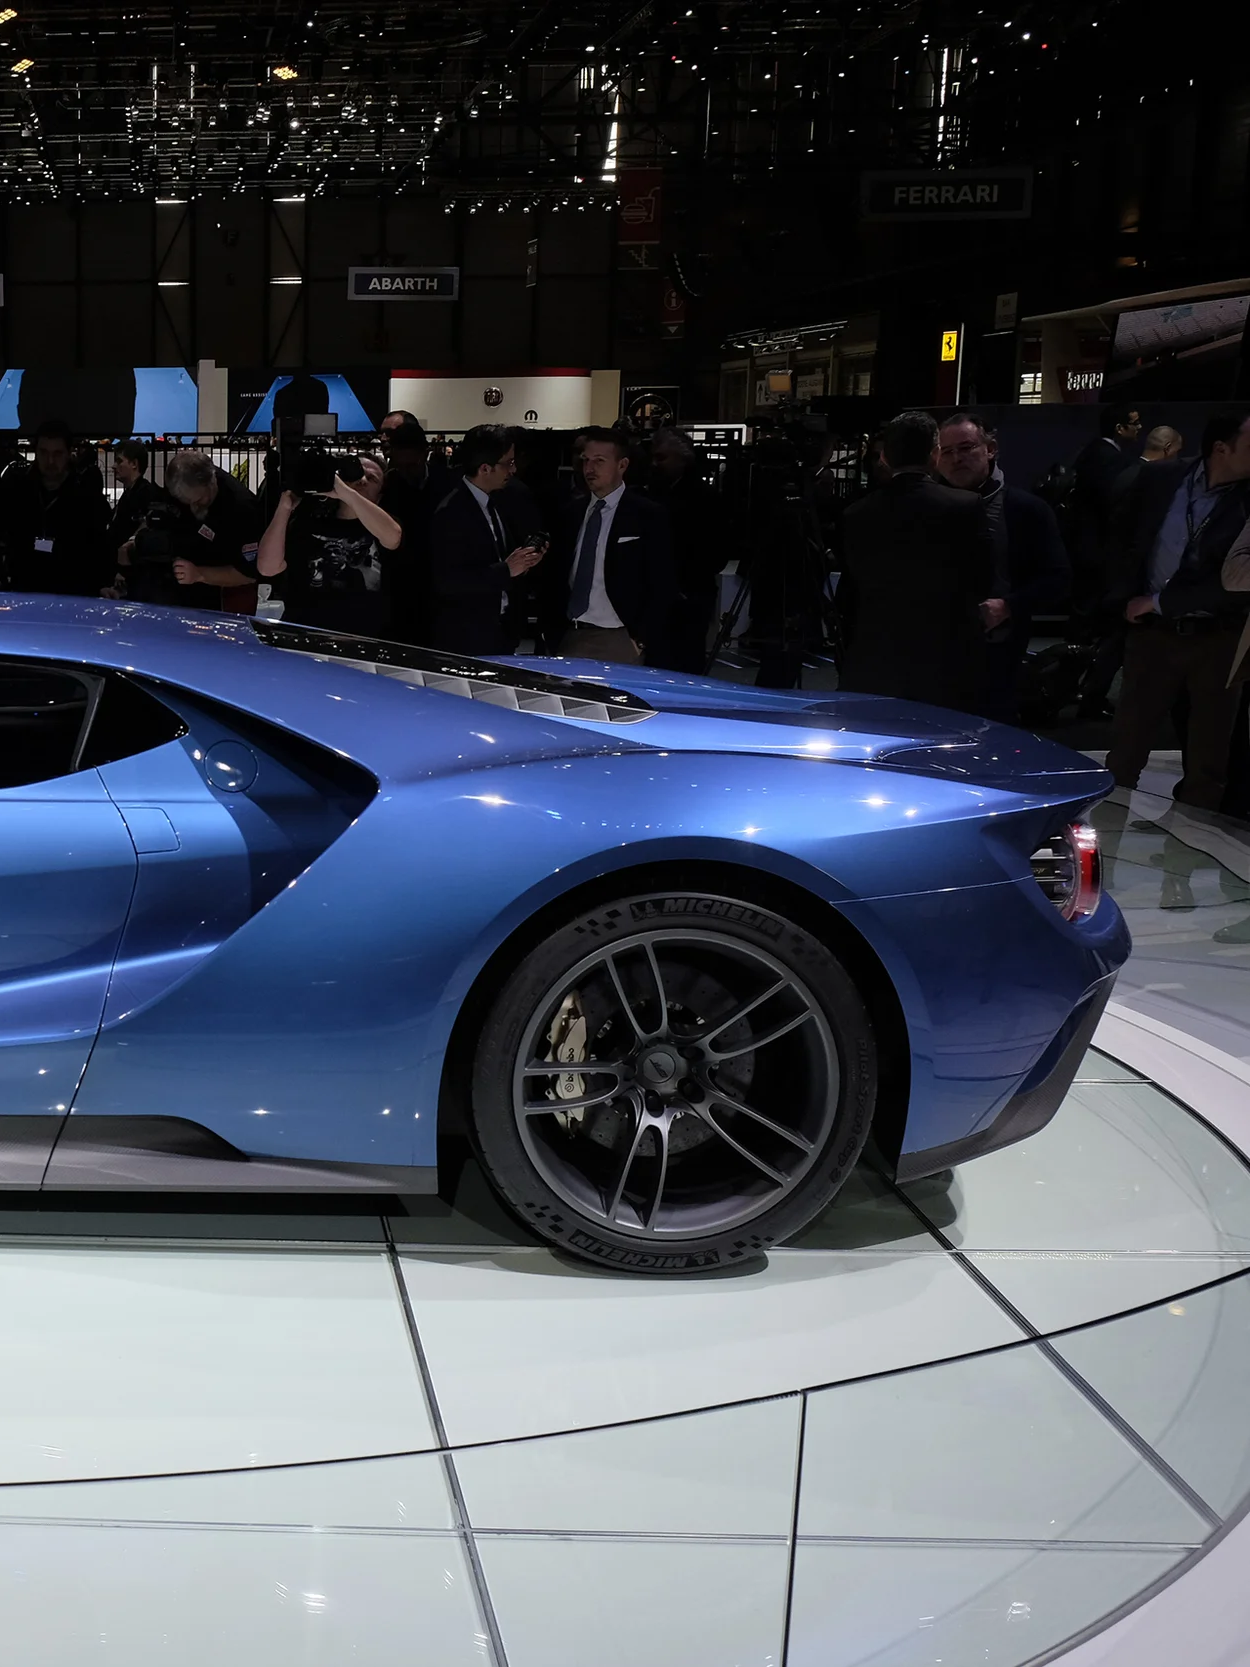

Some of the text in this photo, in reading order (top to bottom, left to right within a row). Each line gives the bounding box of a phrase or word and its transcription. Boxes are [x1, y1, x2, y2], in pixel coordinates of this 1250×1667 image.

[893, 183, 1000, 206] FERRARI
[367, 276, 440, 292] ABARTH
[661, 898, 782, 937] MICHELIN
[857, 1037, 869, 1081] Pilot
[851, 1085, 870, 1135] Sport
[837, 1136, 858, 1168] Cup
[829, 1167, 842, 1184] 2
[569, 1233, 689, 1269] MICHELIN
